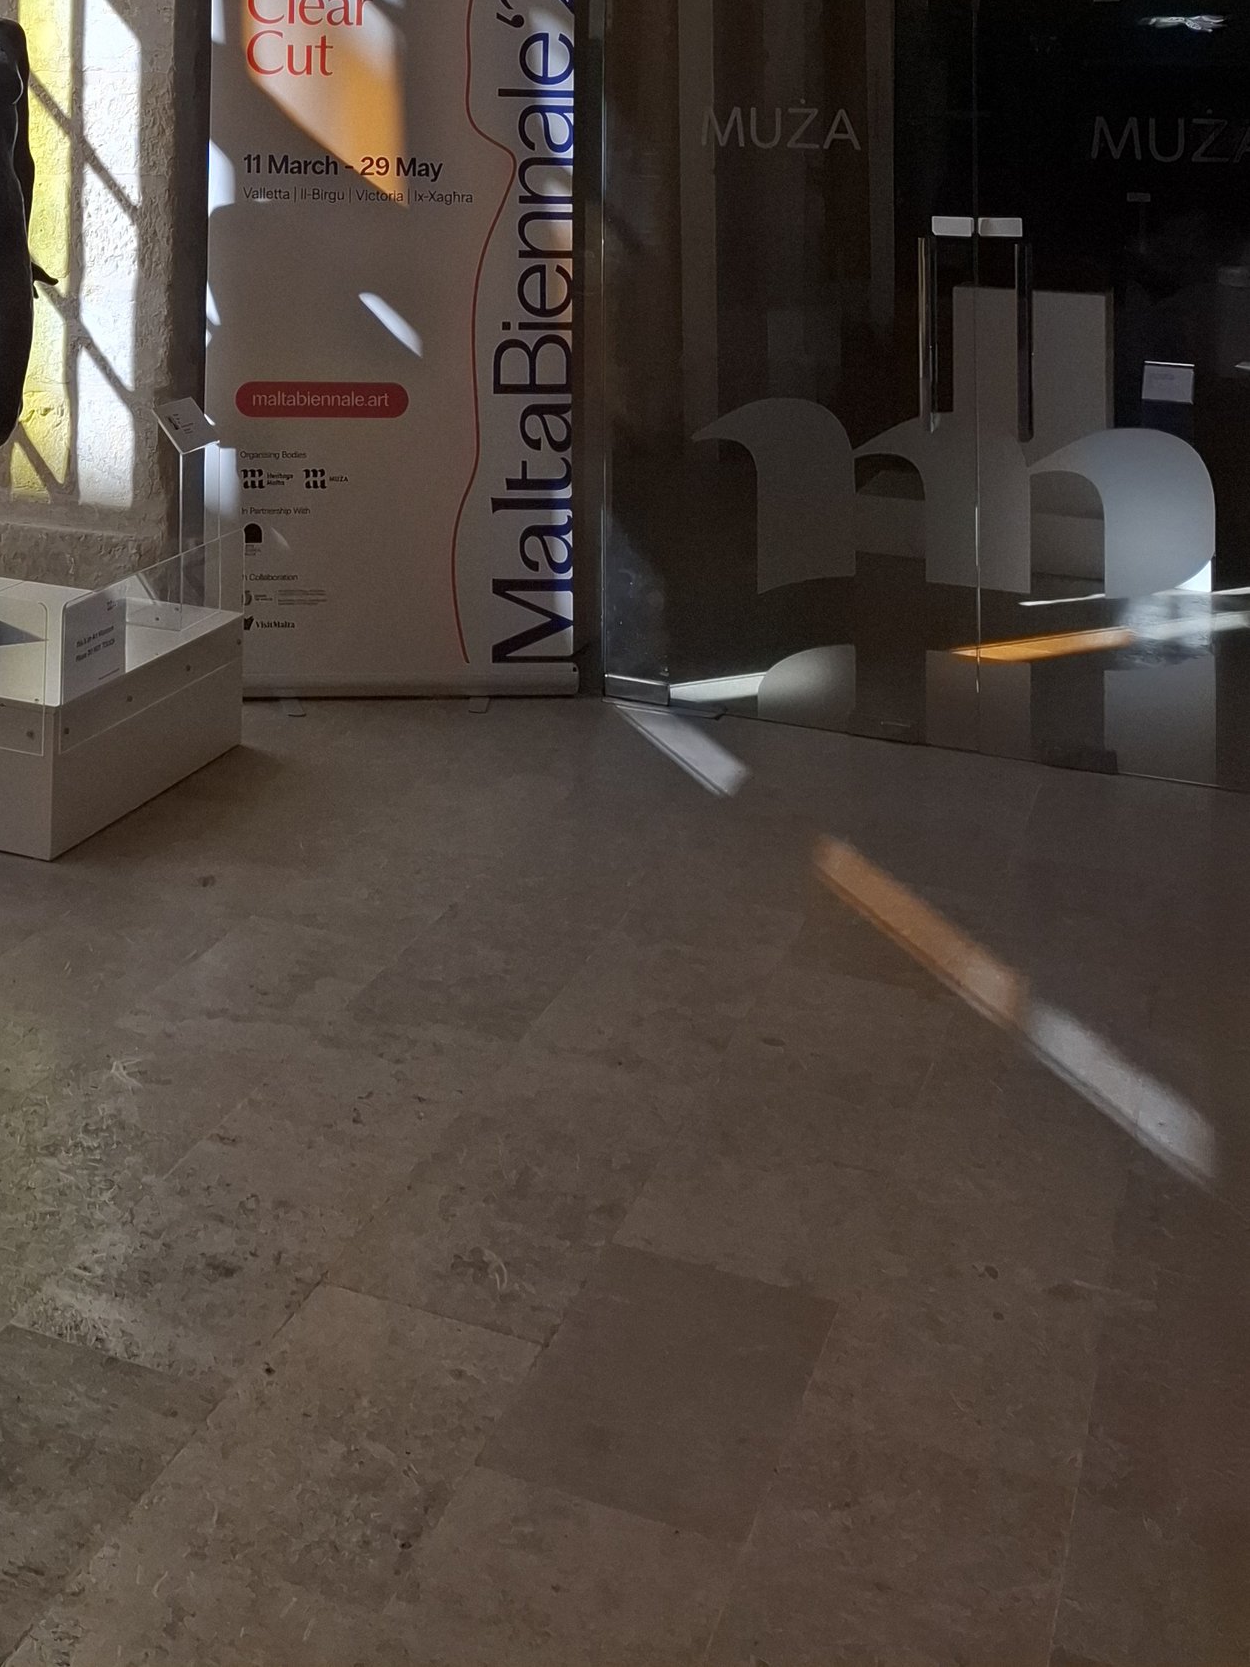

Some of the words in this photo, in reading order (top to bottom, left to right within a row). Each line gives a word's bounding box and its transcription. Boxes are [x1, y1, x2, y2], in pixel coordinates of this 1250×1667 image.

[246, 29, 334, 77] Cut
[701, 98, 862, 151] MUŻA
[243, 154, 261, 174] 11
[268, 154, 338, 176] March
[360, 156, 390, 177] 29
[396, 157, 444, 182] May
[243, 187, 290, 200] Valletta
[300, 187, 345, 203] Il-Birgu
[355, 189, 404, 203] Victoria
[252, 391, 390, 408] maltabiennale.art
[281, 451, 307, 459] Bodies
[250, 507, 291, 516] Partnership
[293, 507, 311, 515] With
[249, 573, 298, 581] Collaboration
